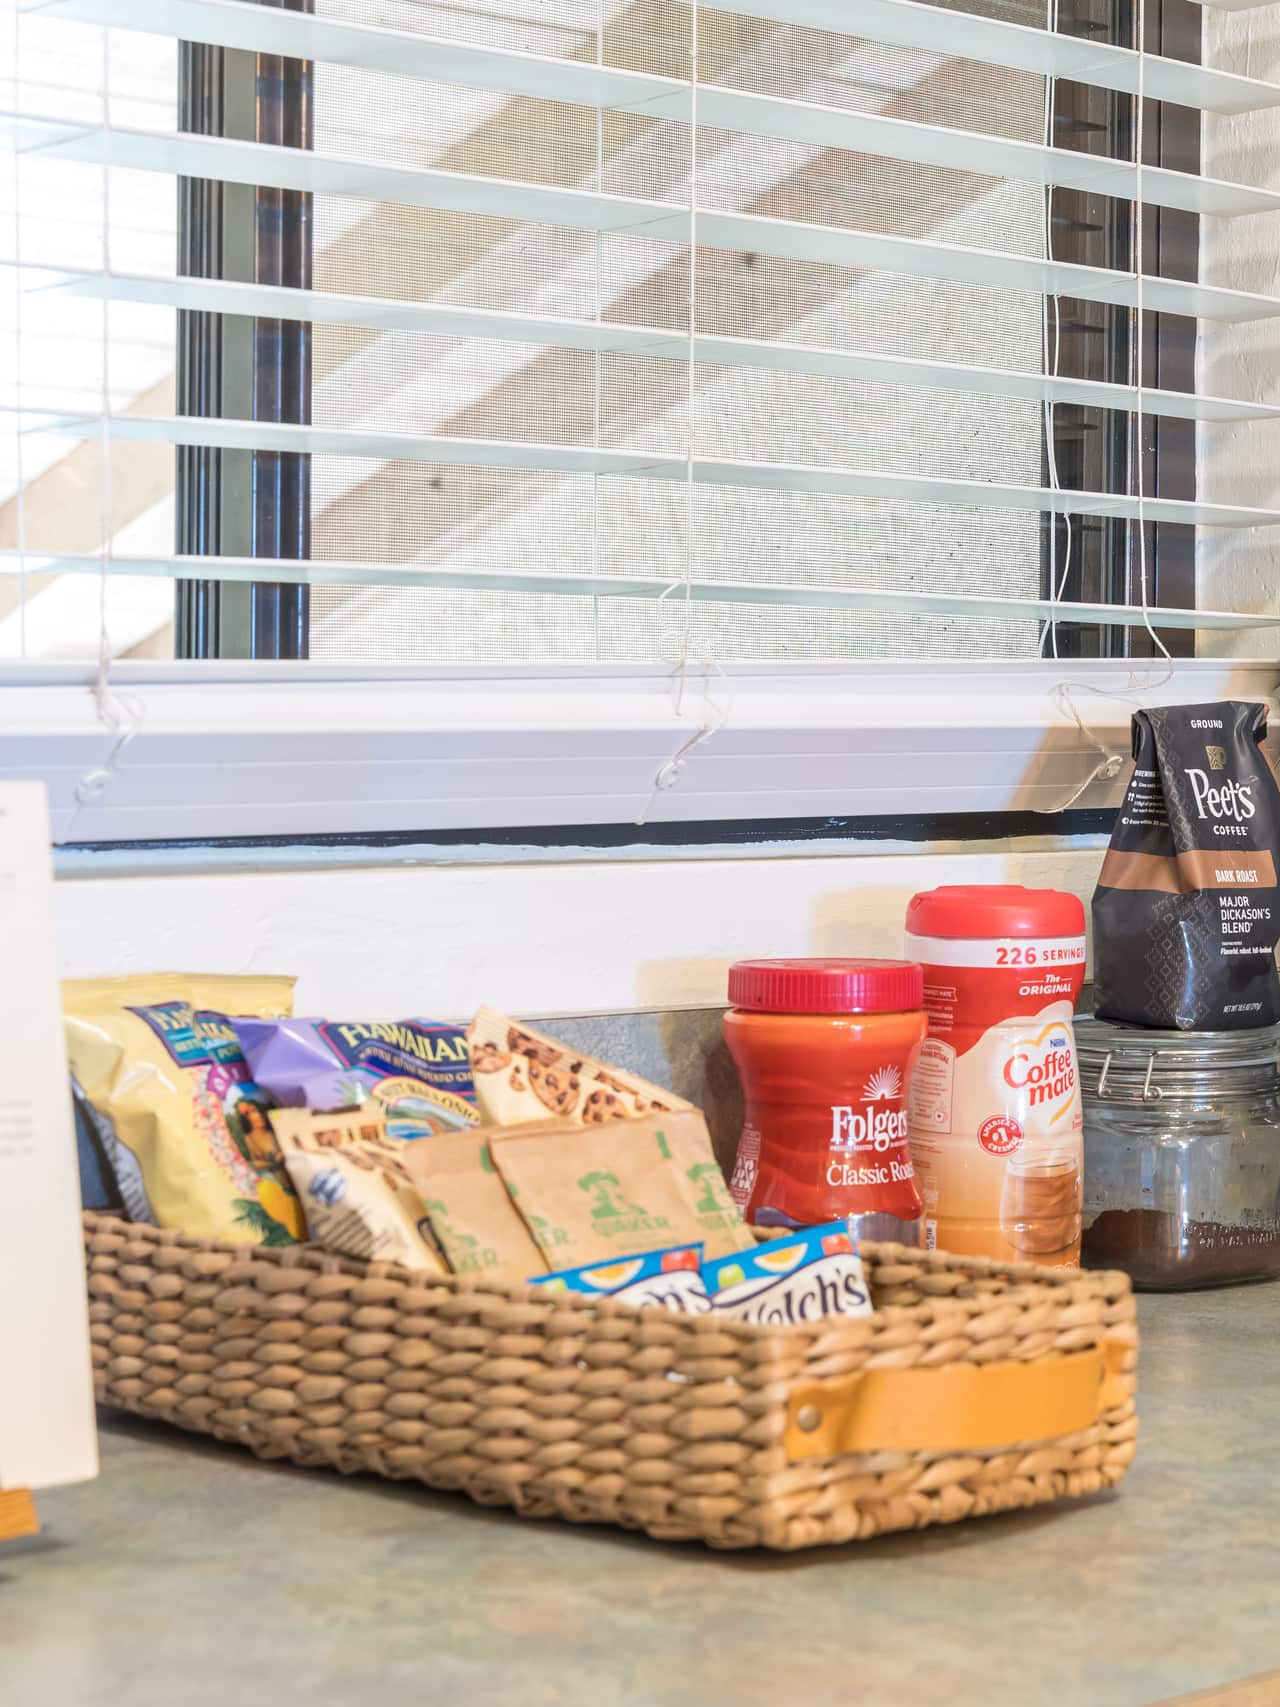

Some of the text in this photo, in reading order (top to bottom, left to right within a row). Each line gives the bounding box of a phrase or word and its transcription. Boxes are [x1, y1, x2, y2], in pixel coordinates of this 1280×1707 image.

[1190, 719, 1223, 729] GROUND
[1184, 768, 1256, 822] Peet's
[1213, 825, 1248, 836] COFFEE
[1215, 869, 1258, 883] DARK ROAST
[1219, 895, 1250, 908] MAJOR
[1220, 908, 1271, 921] DICKASON'S
[996, 947, 1037, 965] 226
[1045, 973, 1061, 983] The
[1019, 984, 1072, 996] ORIGINAL
[1003, 1049, 1072, 1088] Coffee
[1029, 1068, 1074, 1106] mate
[826, 1163, 889, 1186] Classic
